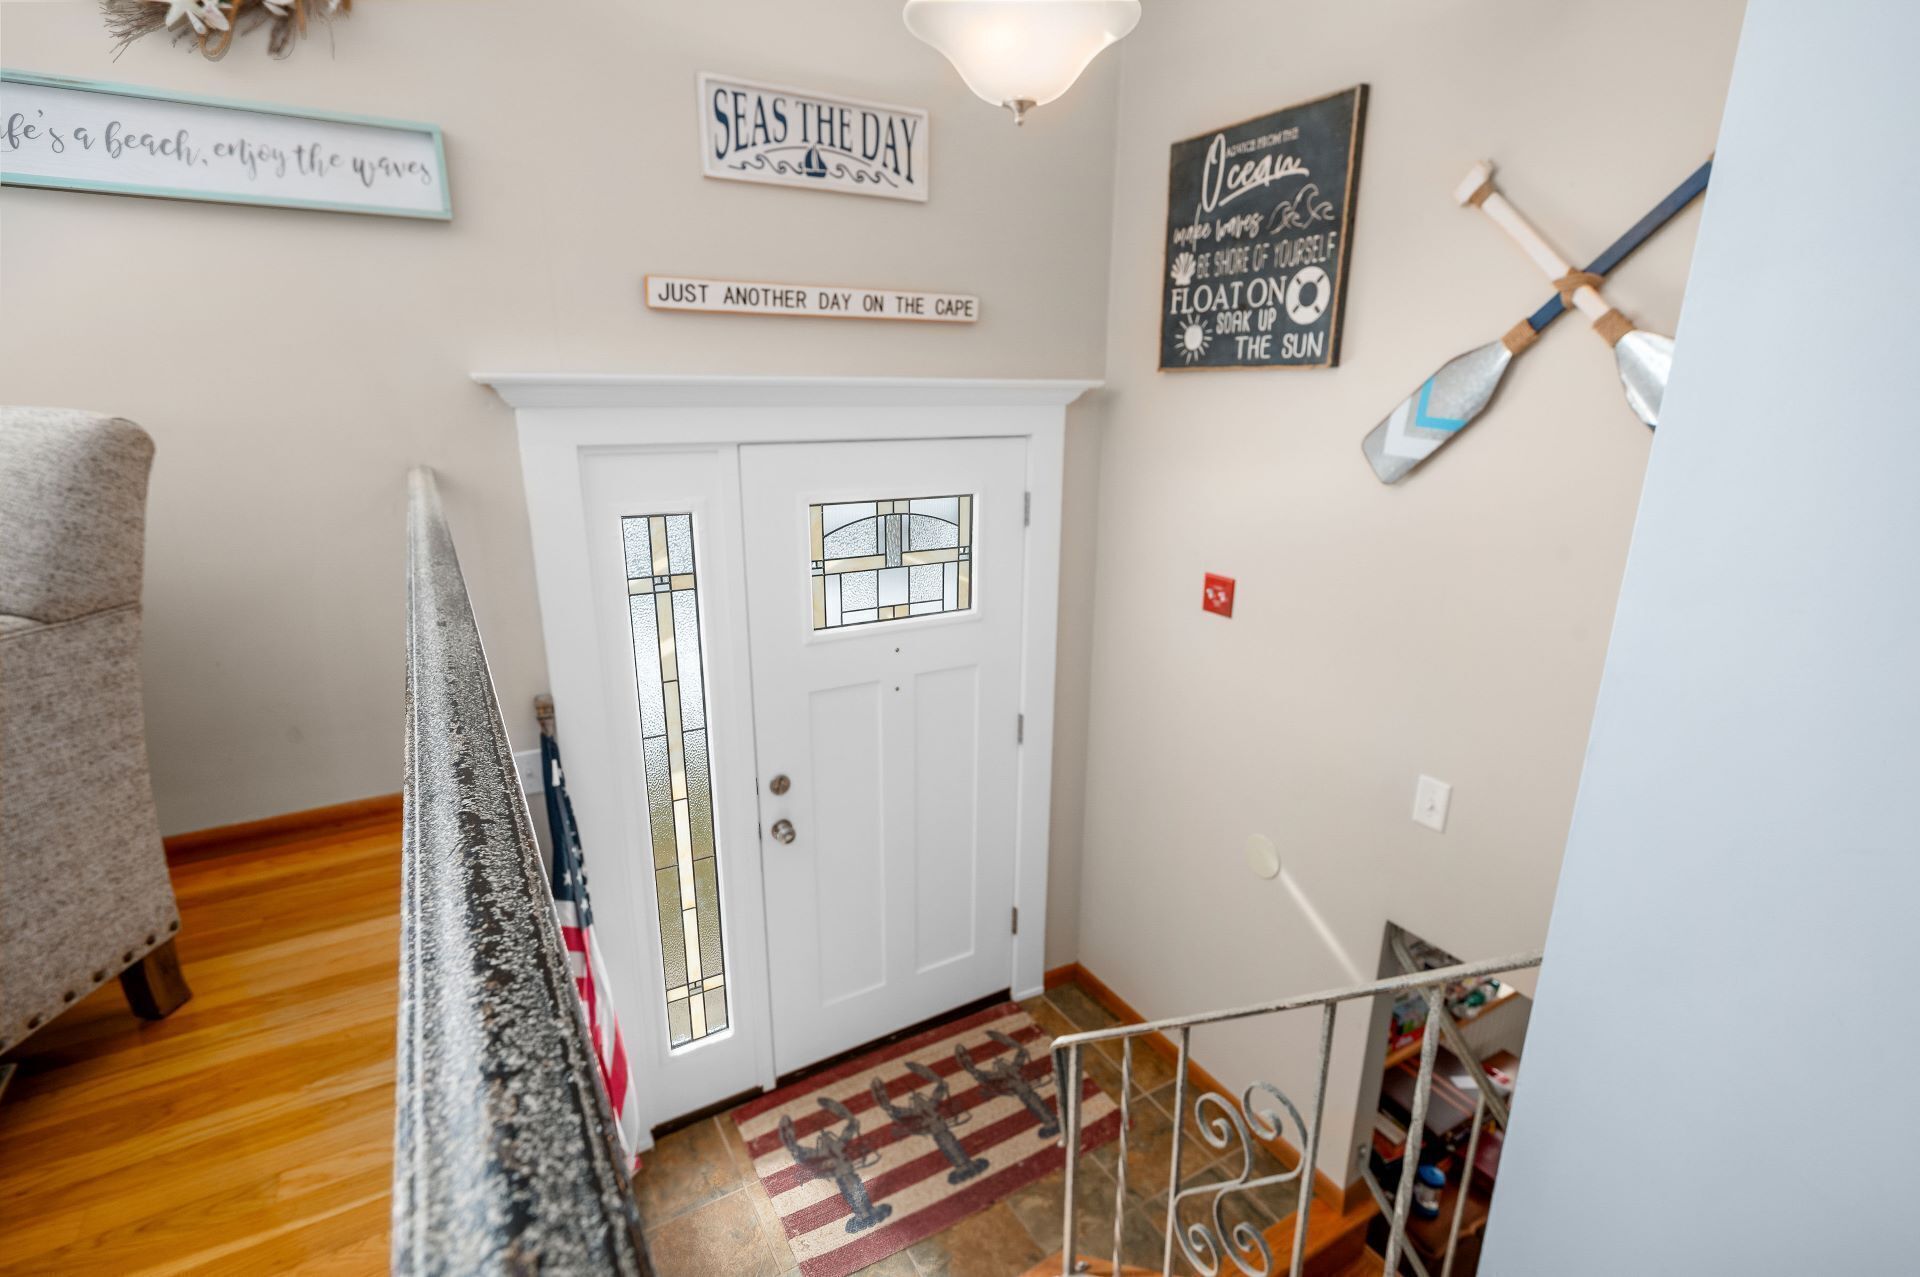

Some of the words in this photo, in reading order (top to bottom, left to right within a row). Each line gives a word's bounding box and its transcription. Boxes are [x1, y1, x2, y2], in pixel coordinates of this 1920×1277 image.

[0, 109, 64, 153] fe's
[73, 127, 96, 150] a
[104, 120, 208, 167] beach,
[213, 138, 287, 181] enjoy
[292, 142, 345, 178] the
[352, 155, 433, 188] waves
[713, 88, 789, 160] SEAS
[796, 101, 853, 153] THE
[862, 112, 918, 184] DAY
[1196, 252, 1211, 280] BE
[1214, 246, 1250, 277] SHORE
[1252, 242, 1271, 272] OF
[1273, 231, 1338, 269] YOURSELF
[658, 282, 709, 304] JUST
[723, 286, 807, 309] ANOTHER
[819, 292, 852, 312] DAY
[862, 294, 885, 313] ON
[895, 296, 925, 315] THE
[935, 298, 973, 317] CAPE
[1170, 281, 1244, 315] FLOAT
[1247, 275, 1288, 309] ON
[1216, 308, 1252, 335] SOAK
[1257, 307, 1277, 332] UP
[1234, 334, 1273, 361] THE
[1280, 331, 1325, 360] SUN
